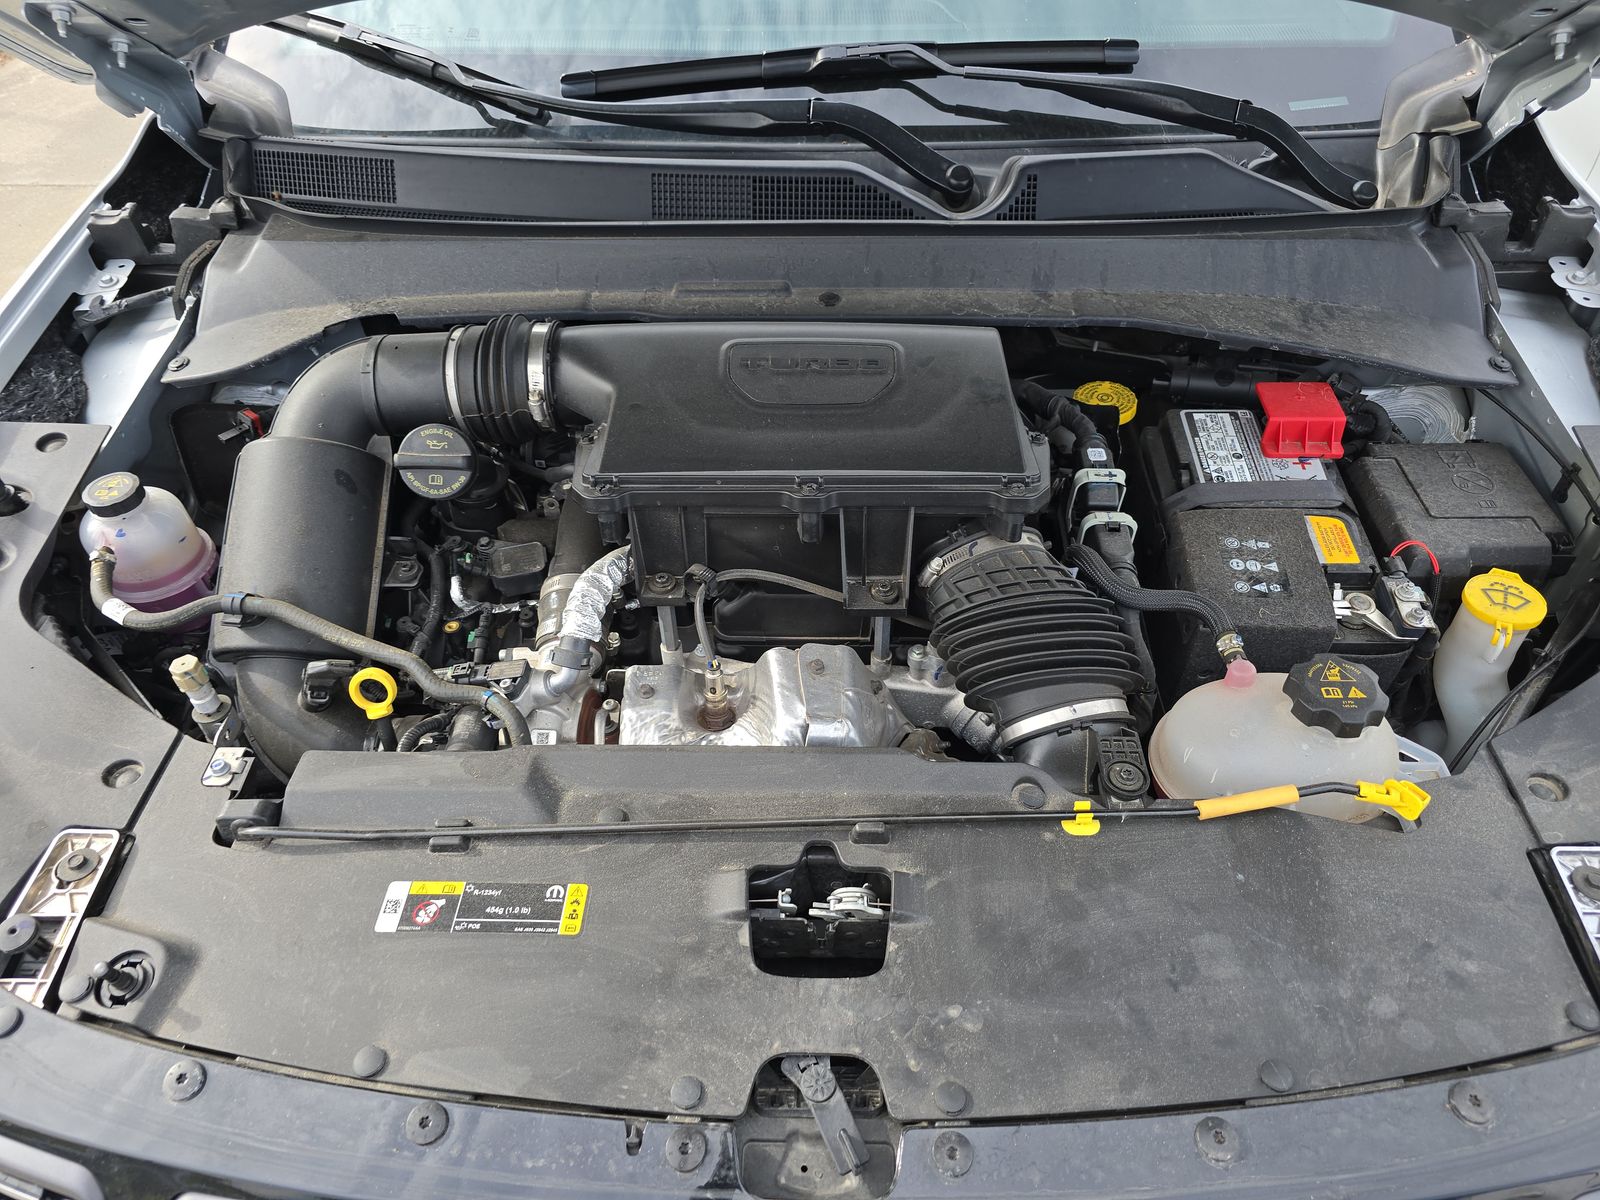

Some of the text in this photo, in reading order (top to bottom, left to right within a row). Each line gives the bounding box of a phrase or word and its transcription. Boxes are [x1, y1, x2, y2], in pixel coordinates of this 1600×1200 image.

[740, 355, 888, 373] TURBO
[444, 430, 454, 439] OIL
[406, 471, 415, 482] API
[473, 888, 502, 898] R-1234yf
[485, 906, 532, 915] 454g (1.0 lb)
